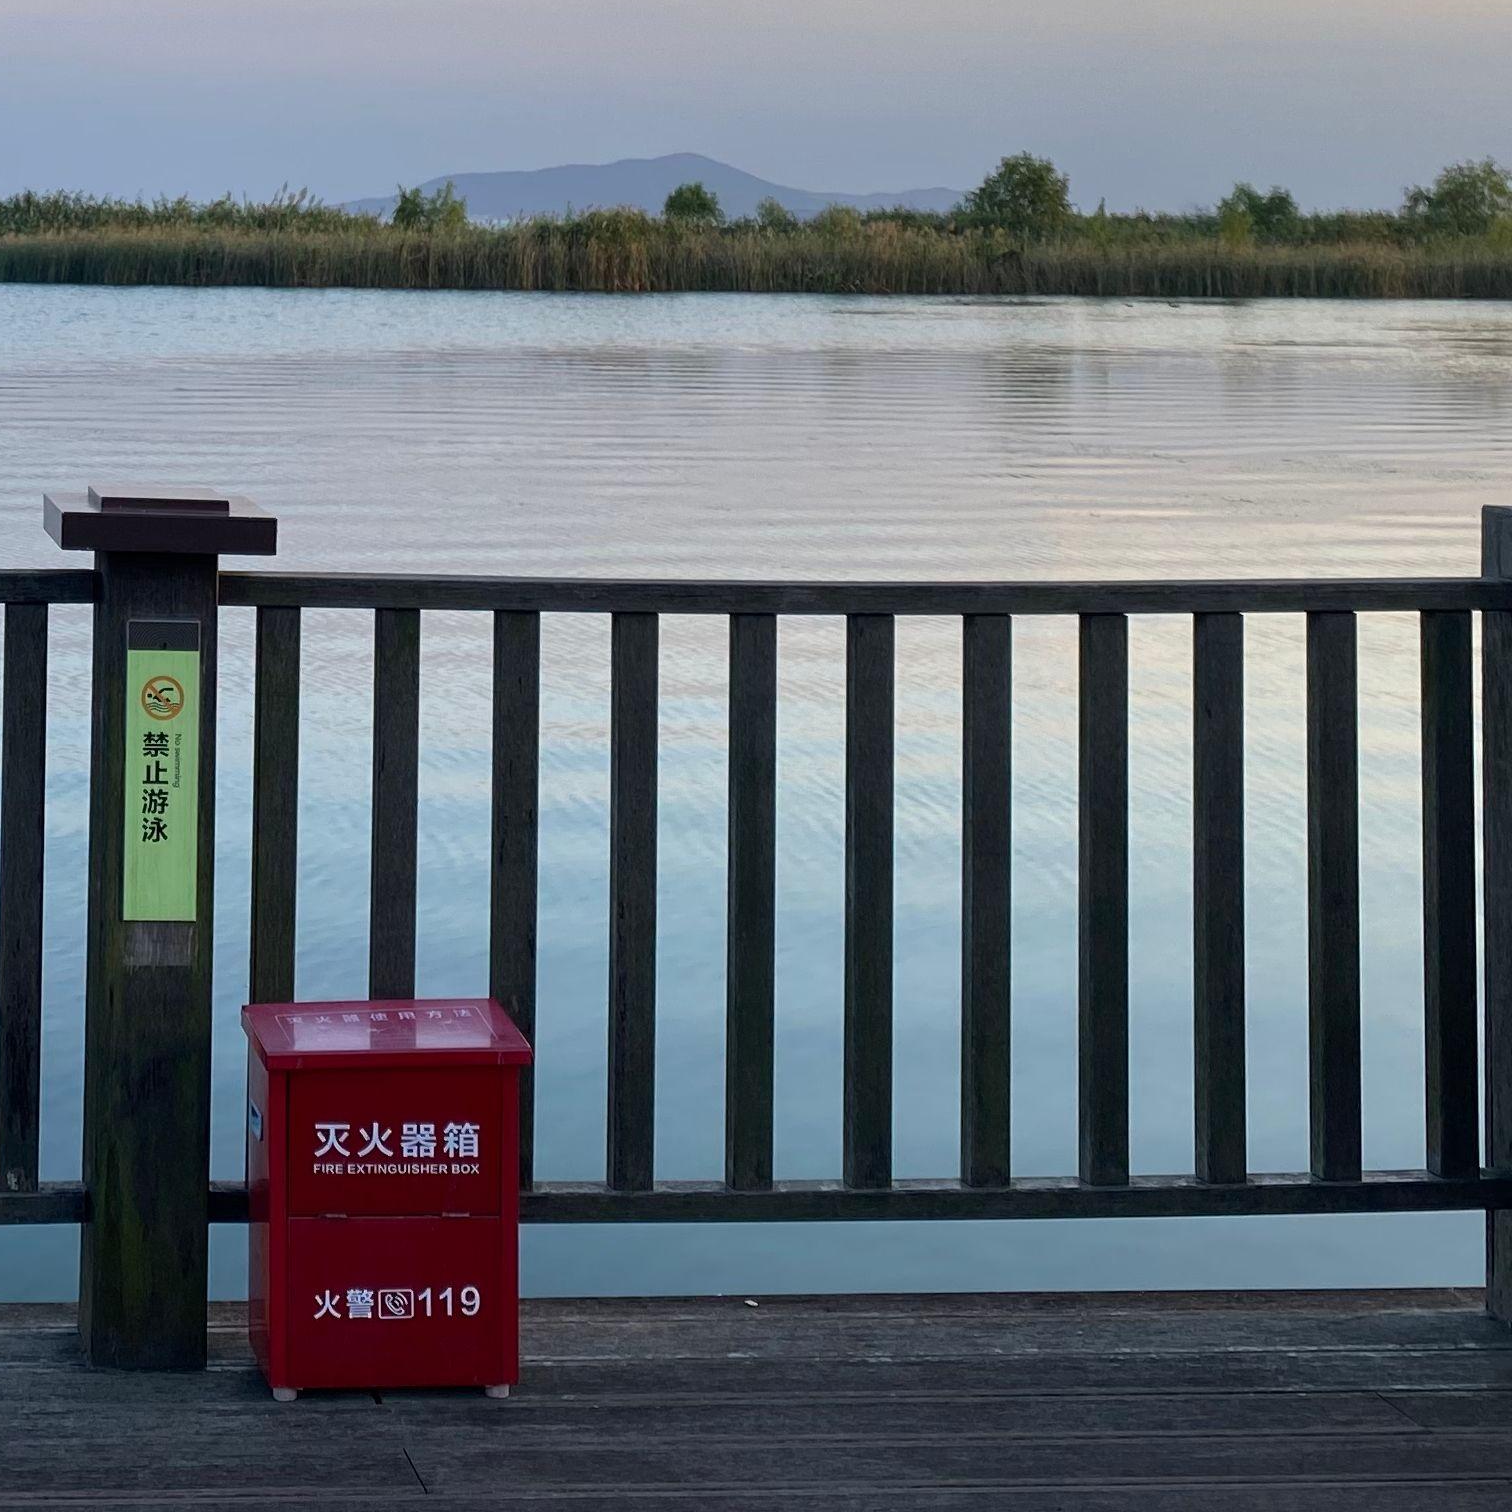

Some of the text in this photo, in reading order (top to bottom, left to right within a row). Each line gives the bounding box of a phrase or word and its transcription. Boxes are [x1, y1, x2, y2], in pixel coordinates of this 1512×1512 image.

[172, 734, 182, 788] No swimming
[142, 731, 169, 843] 禁止游泳
[314, 1122, 480, 1157] 灭火器箱
[313, 1163, 480, 1175] FIRE EXTINGUISHER BOX
[313, 1286, 481, 1319] 火警 119
